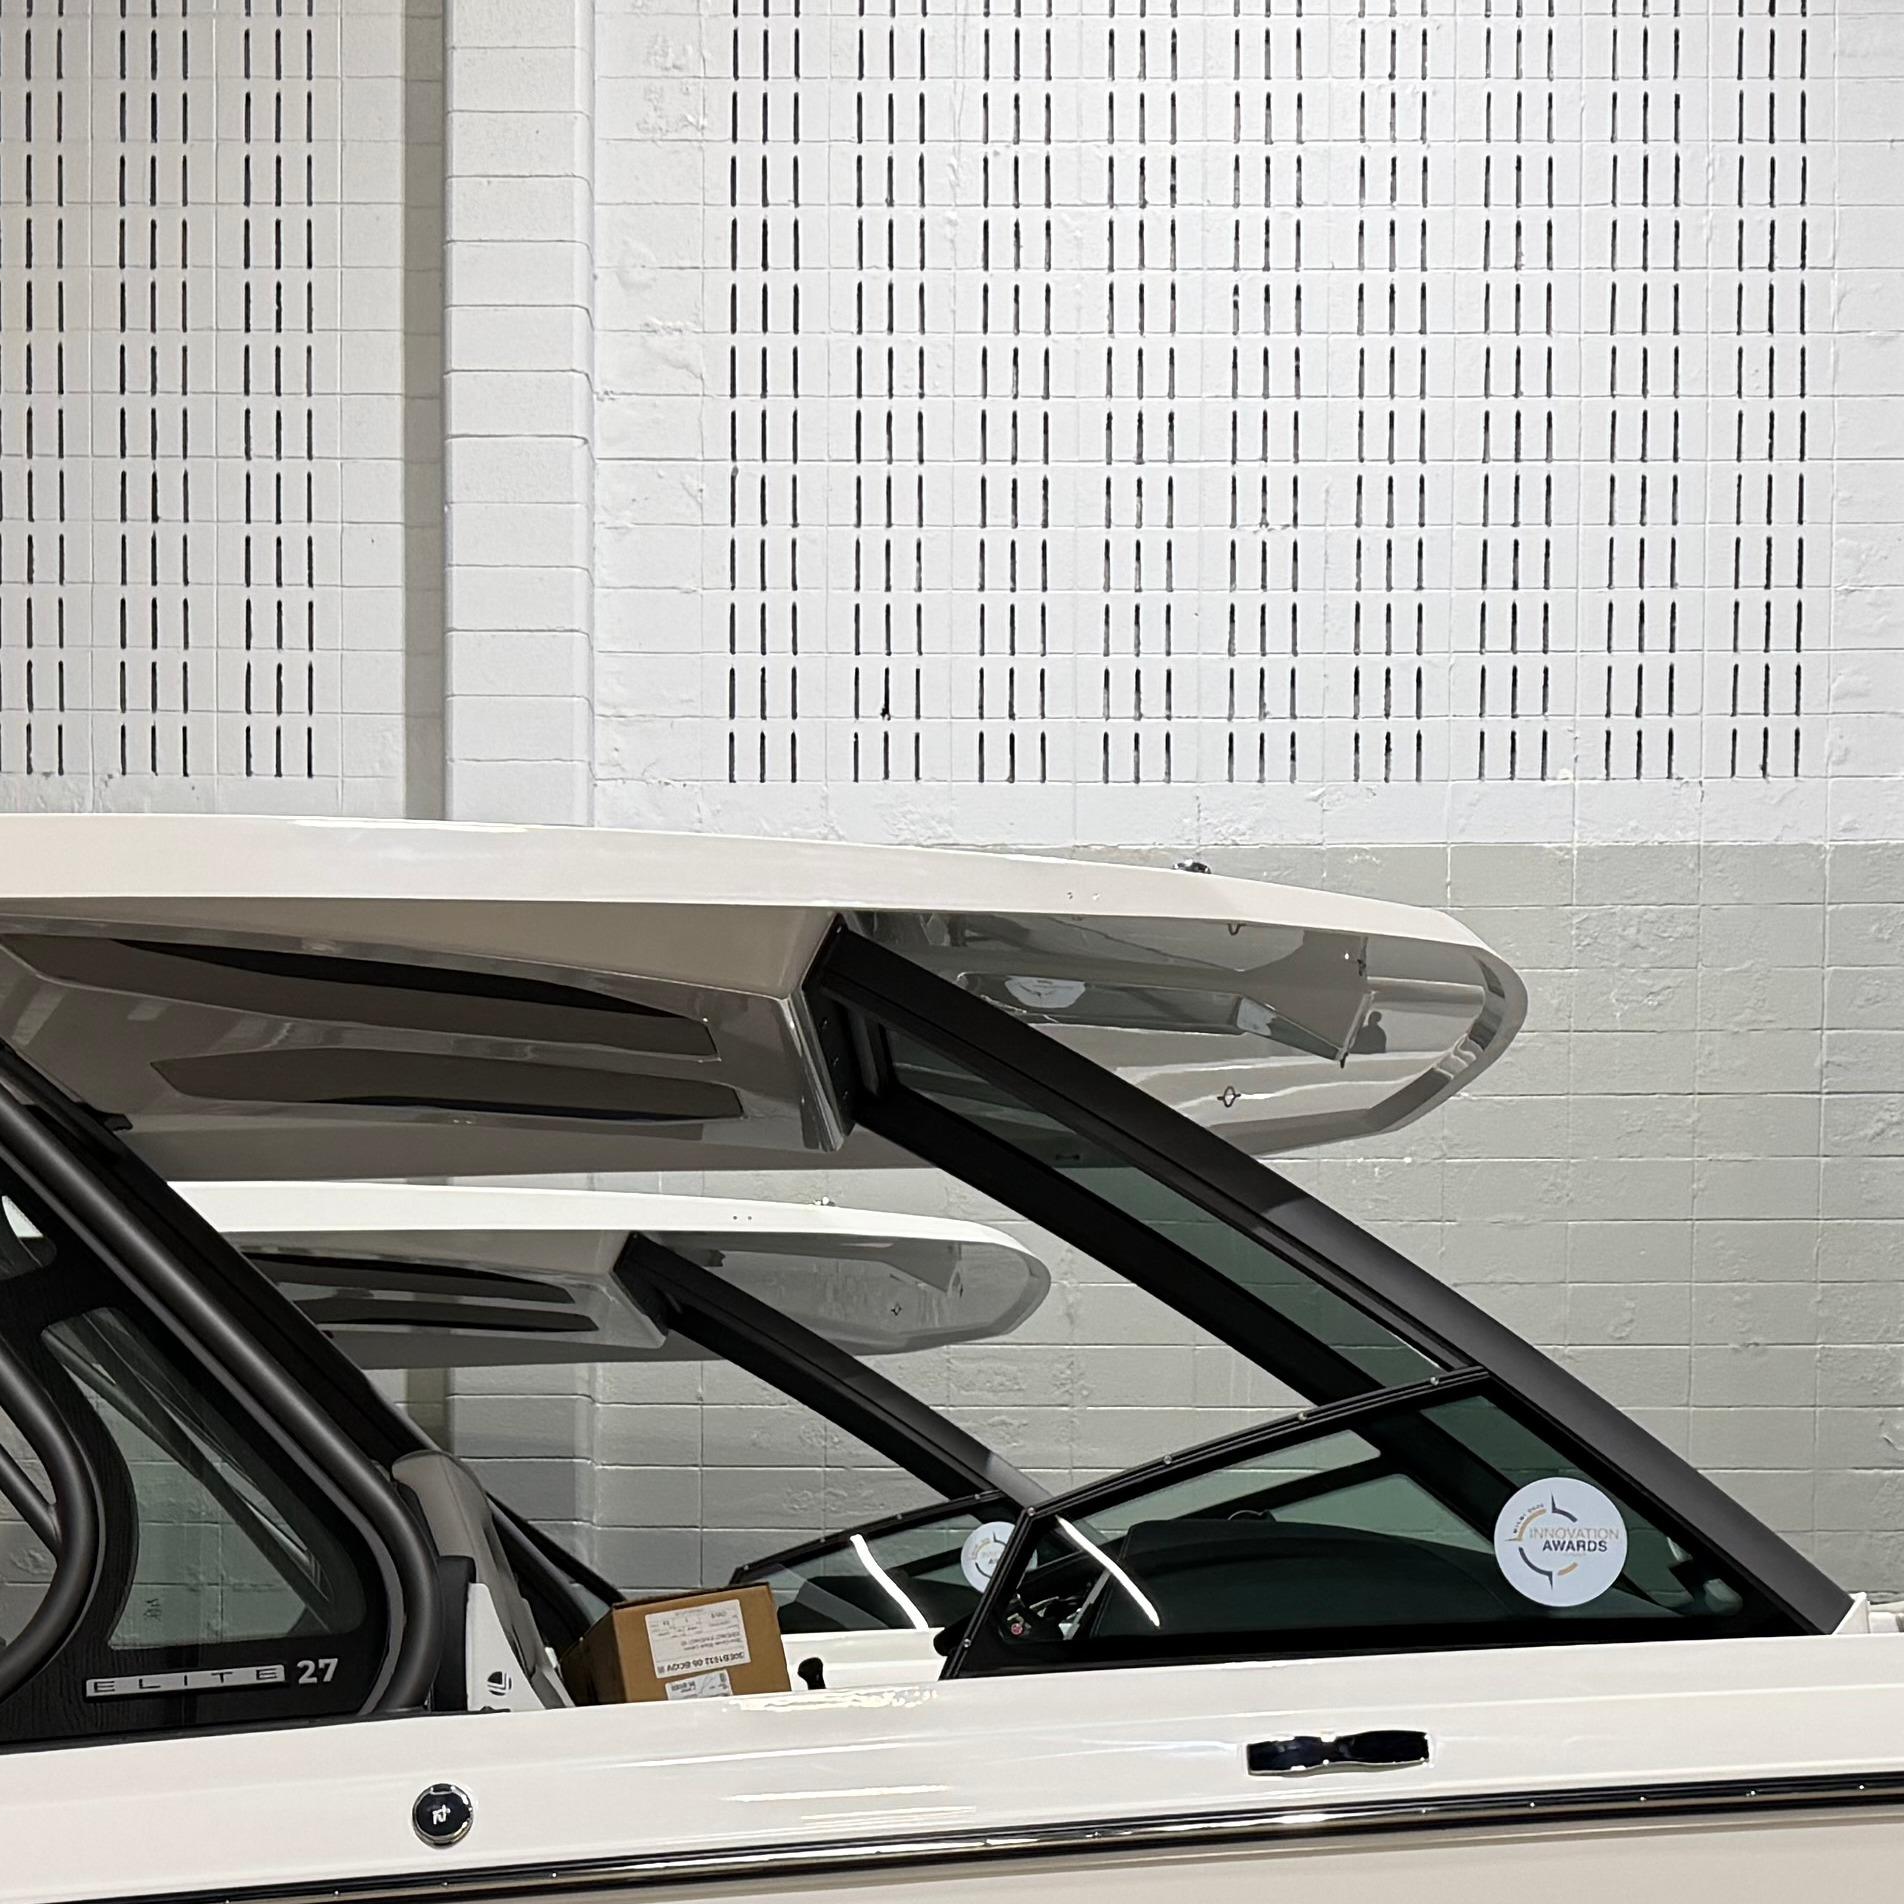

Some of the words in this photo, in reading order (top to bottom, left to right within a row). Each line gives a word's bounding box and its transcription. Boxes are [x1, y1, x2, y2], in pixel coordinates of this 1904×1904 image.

[1529, 1527, 1619, 1540] INNOVATION
[1542, 1540, 1608, 1553] AWARDS
[93, 1667, 278, 1694] ELITE
[297, 1657, 338, 1684] 27
